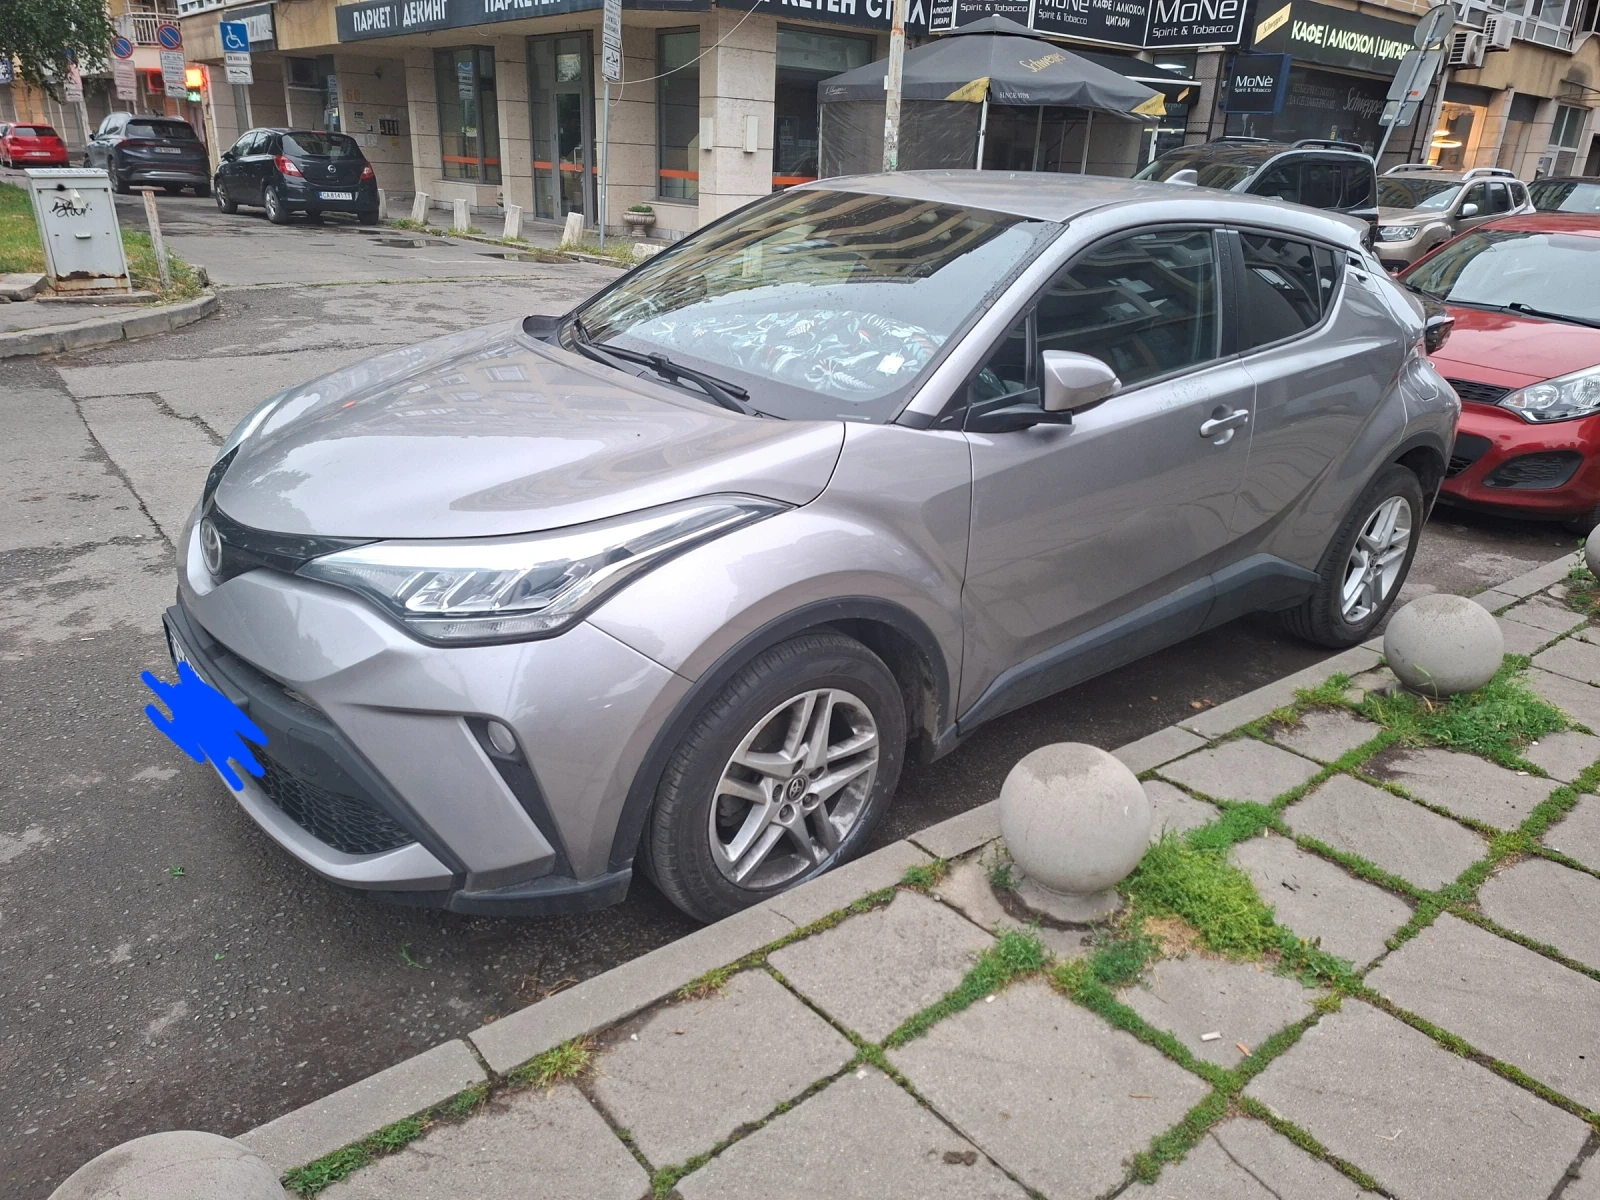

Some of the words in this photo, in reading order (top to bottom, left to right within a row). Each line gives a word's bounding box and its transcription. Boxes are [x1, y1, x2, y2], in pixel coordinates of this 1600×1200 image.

[960, 3, 982, 12] Spirit
[993, 4, 1028, 12] Tobacco
[1116, 2, 1146, 16] АЛКОХОЛ
[353, 6, 390, 32] ПАРКЕТ
[403, 0, 447, 28] ДЕКИНГ
[1038, 9, 1055, 20] Spirit
[1063, 13, 1088, 25] Tobacco
[1105, 15, 1130, 28] ЦИГАРИ
[1152, 27, 1178, 38] Spirit
[1192, 24, 1234, 35] Tobacco
[1291, 20, 1324, 44] КАФЕ
[1327, 28, 1374, 55] АЛКОХОЛ
